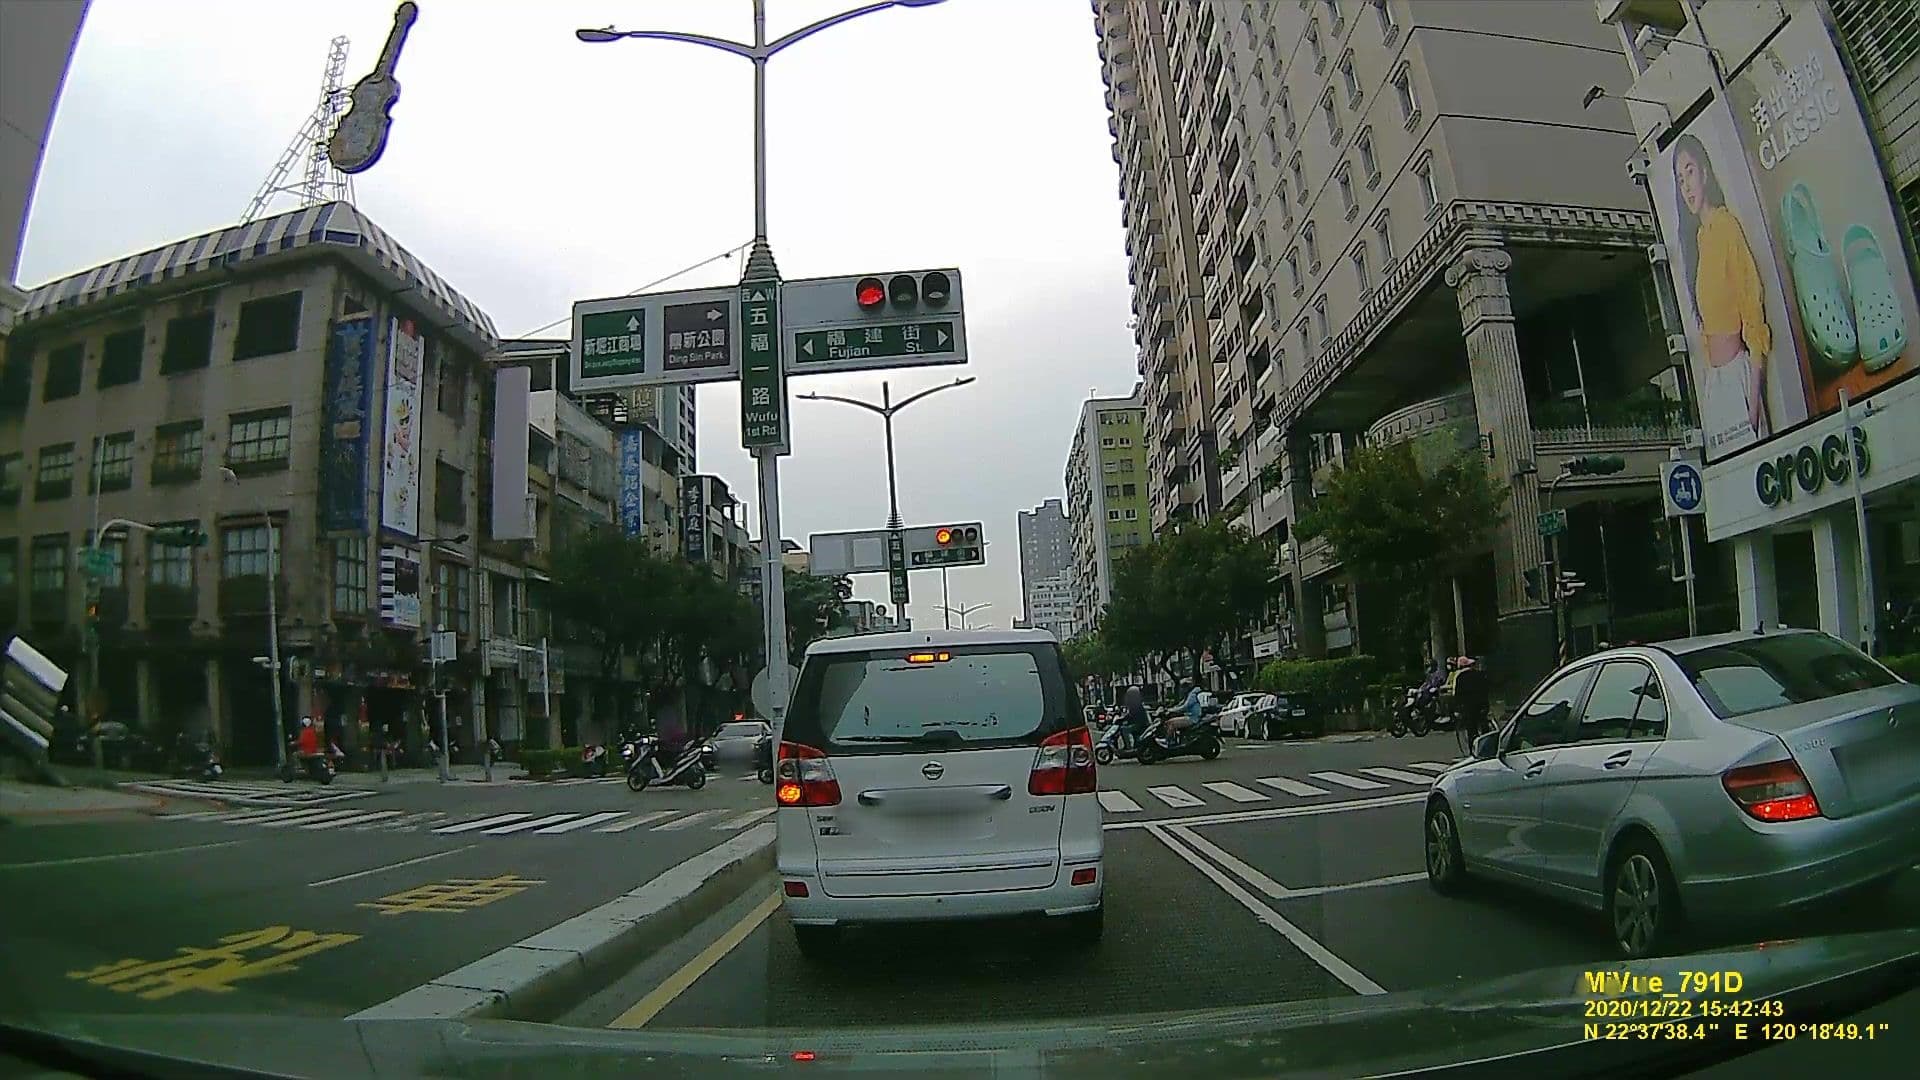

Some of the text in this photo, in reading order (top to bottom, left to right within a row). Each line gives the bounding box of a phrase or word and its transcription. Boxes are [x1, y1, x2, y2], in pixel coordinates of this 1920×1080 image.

[1759, 84, 1839, 170] CLASSIC
[827, 325, 920, 346] 福建街
[705, 350, 723, 360] Park
[750, 307, 770, 405] 五福一路
[829, 346, 870, 359] Fujian
[745, 411, 778, 422] Wufu
[746, 426, 760, 437] 1st
[1755, 424, 1872, 508] crocs
